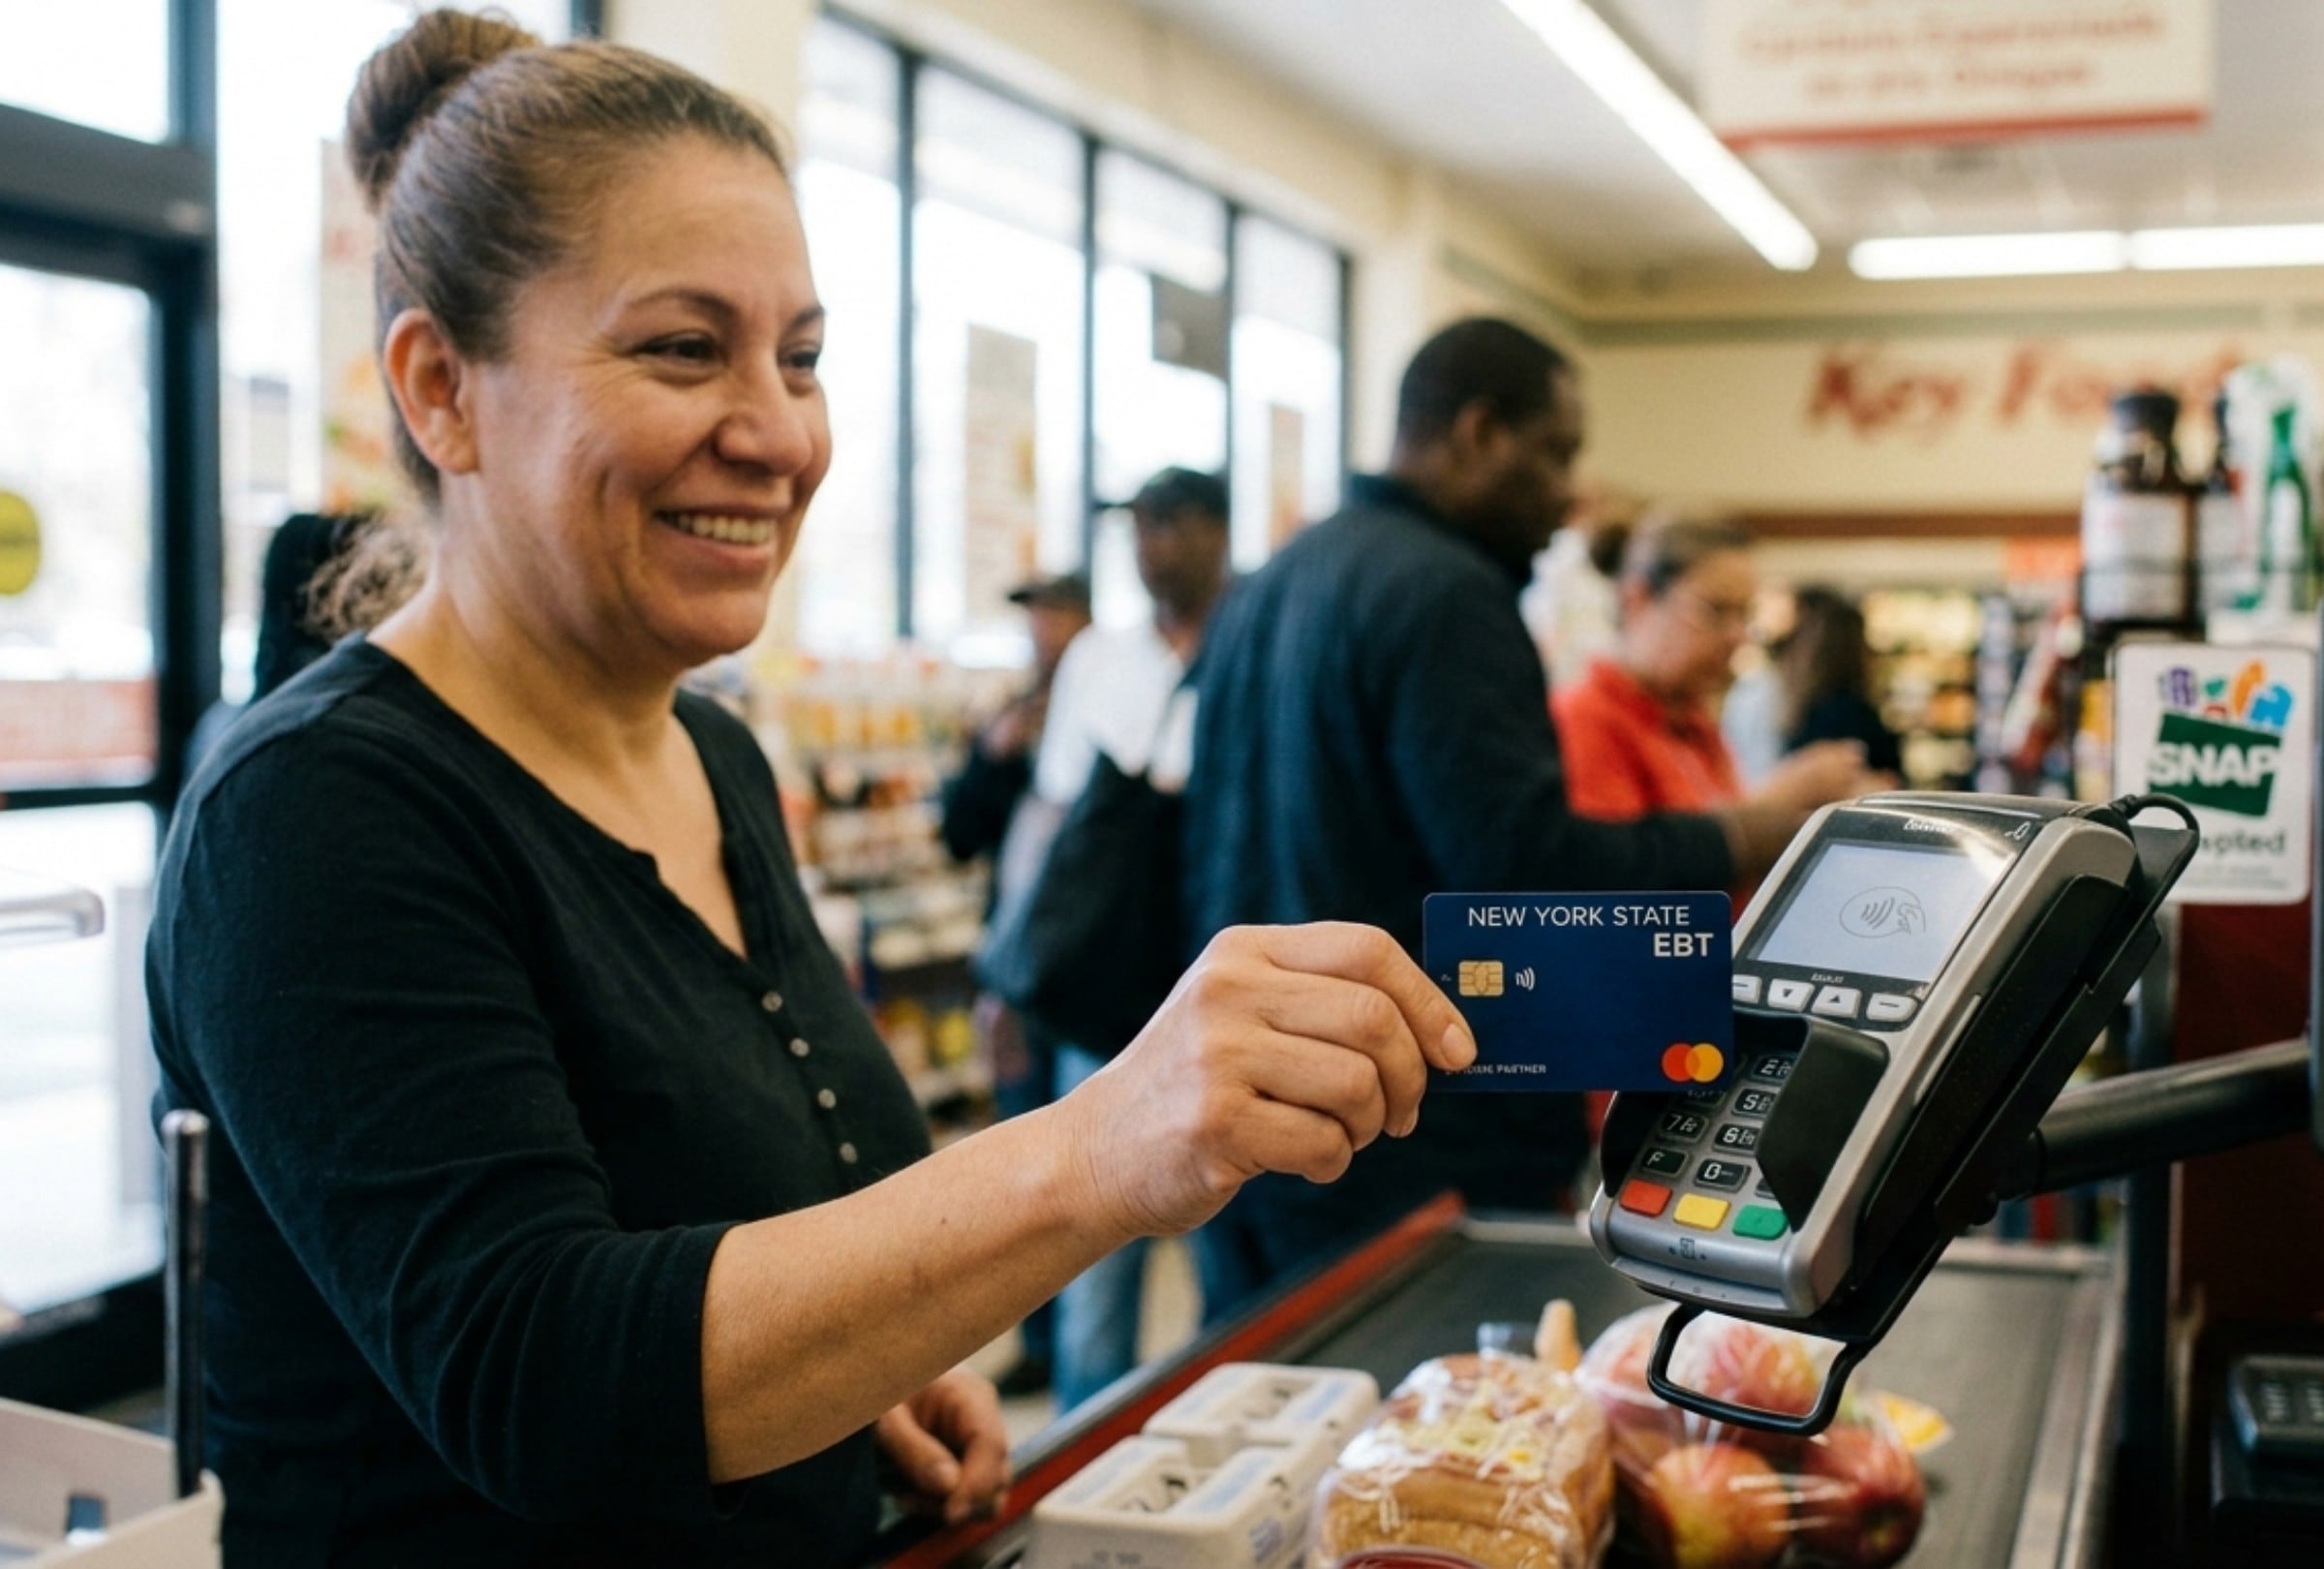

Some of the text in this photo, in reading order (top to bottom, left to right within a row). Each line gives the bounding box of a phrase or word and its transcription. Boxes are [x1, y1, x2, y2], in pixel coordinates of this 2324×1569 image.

[2150, 743, 2278, 787] SNAP
[1468, 906, 1690, 926] NEW YORK STATE
[1654, 933, 1714, 957] EBT
